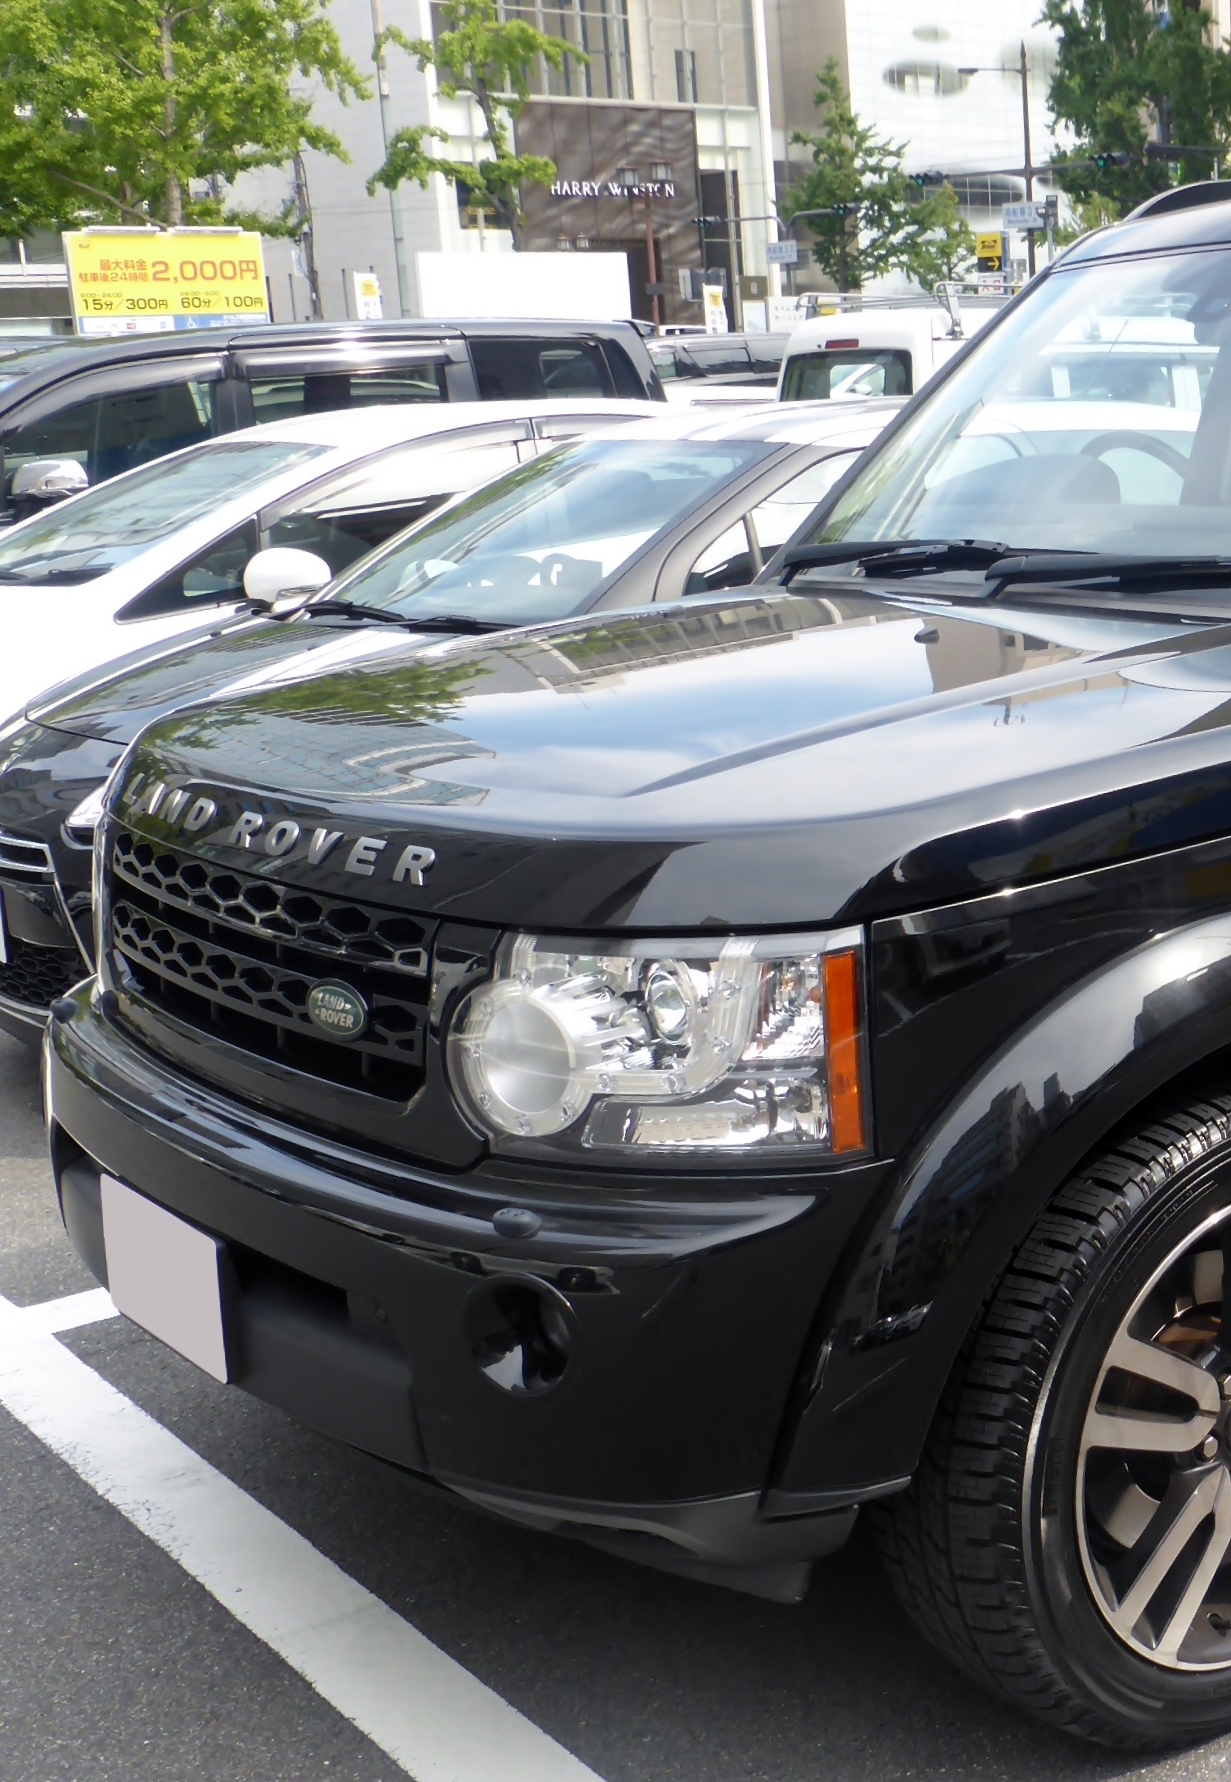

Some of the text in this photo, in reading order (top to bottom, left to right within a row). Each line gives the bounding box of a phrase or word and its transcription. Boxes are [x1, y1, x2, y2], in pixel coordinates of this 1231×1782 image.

[551, 180, 601, 197] HARRY
[78, 271, 149, 283] 駐車後24時間
[99, 258, 259, 284] 最大料金 2,000円
[122, 773, 437, 886] LAND ROVER
[316, 992, 345, 1010] LAND
[320, 1007, 354, 1028] ROVER
